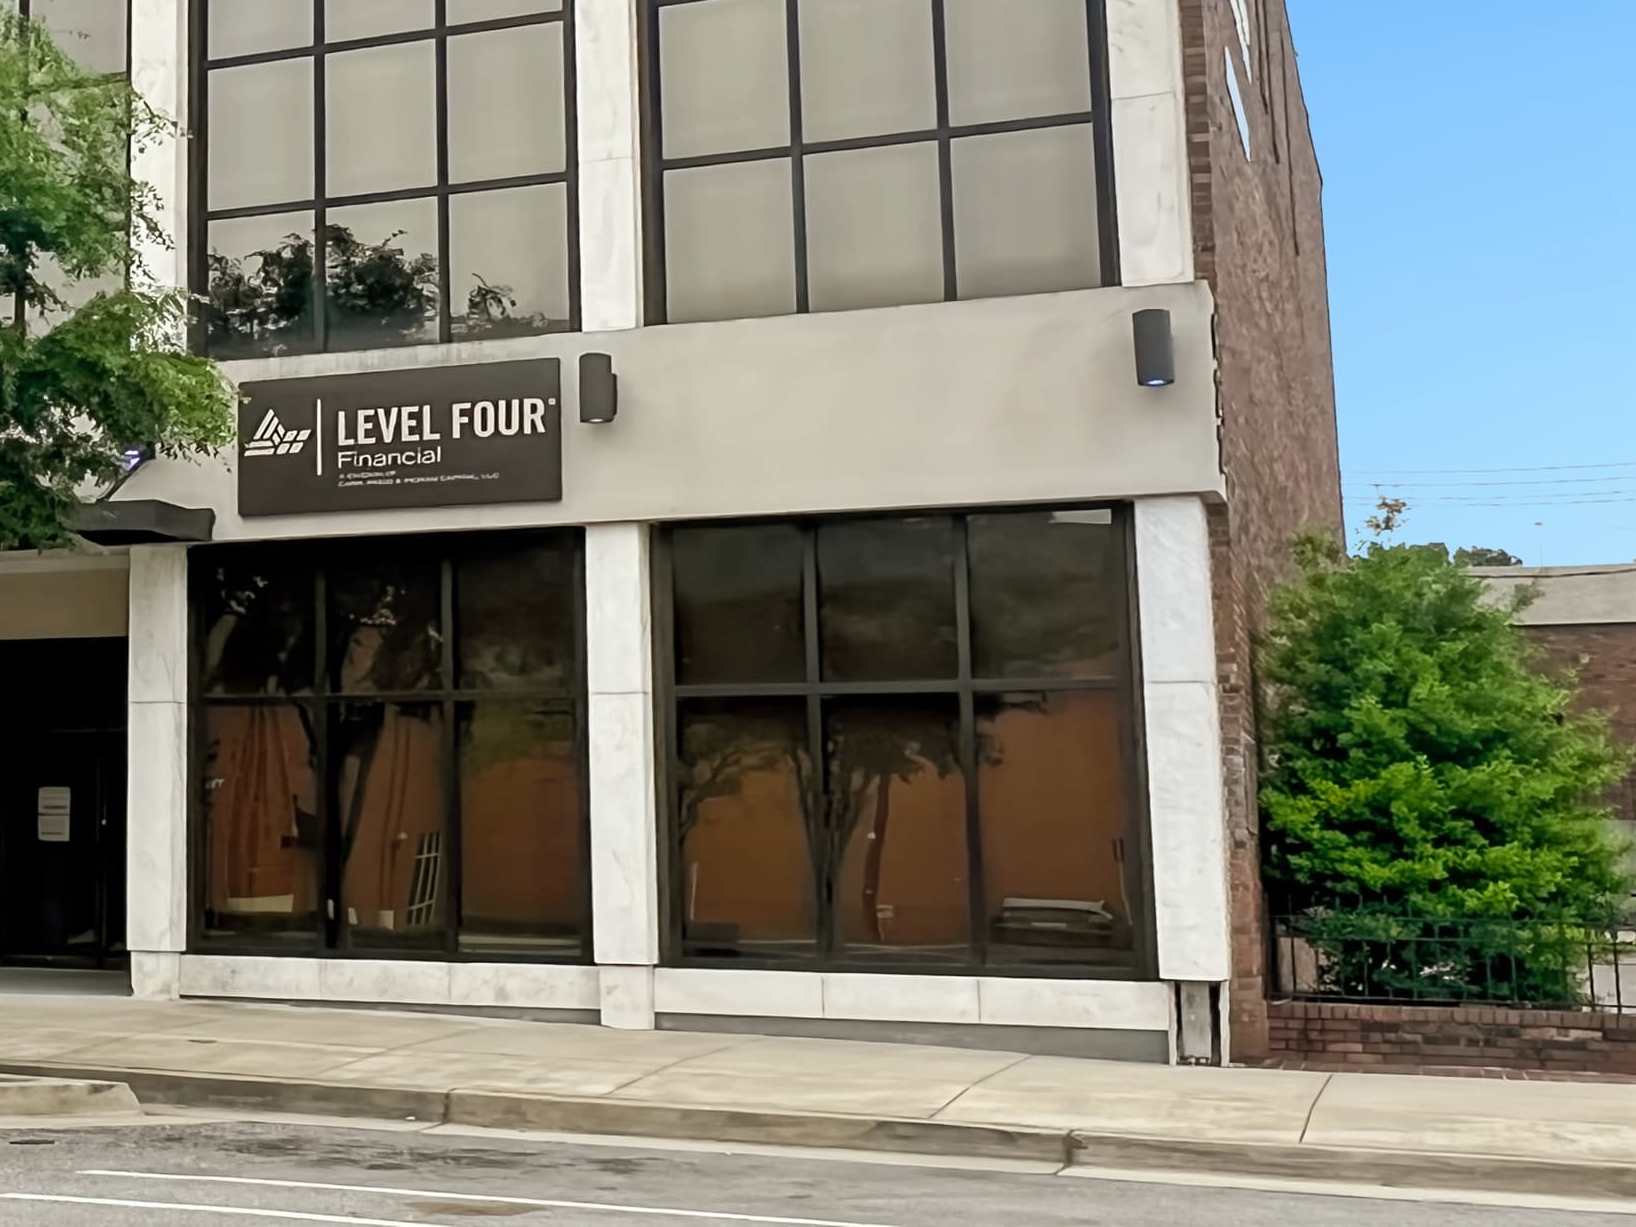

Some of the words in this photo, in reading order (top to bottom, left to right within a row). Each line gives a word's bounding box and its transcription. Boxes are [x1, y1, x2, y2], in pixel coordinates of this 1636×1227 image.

[338, 405, 441, 446] LEVEL
[452, 398, 546, 439] FOUR
[338, 446, 441, 469] Financial
